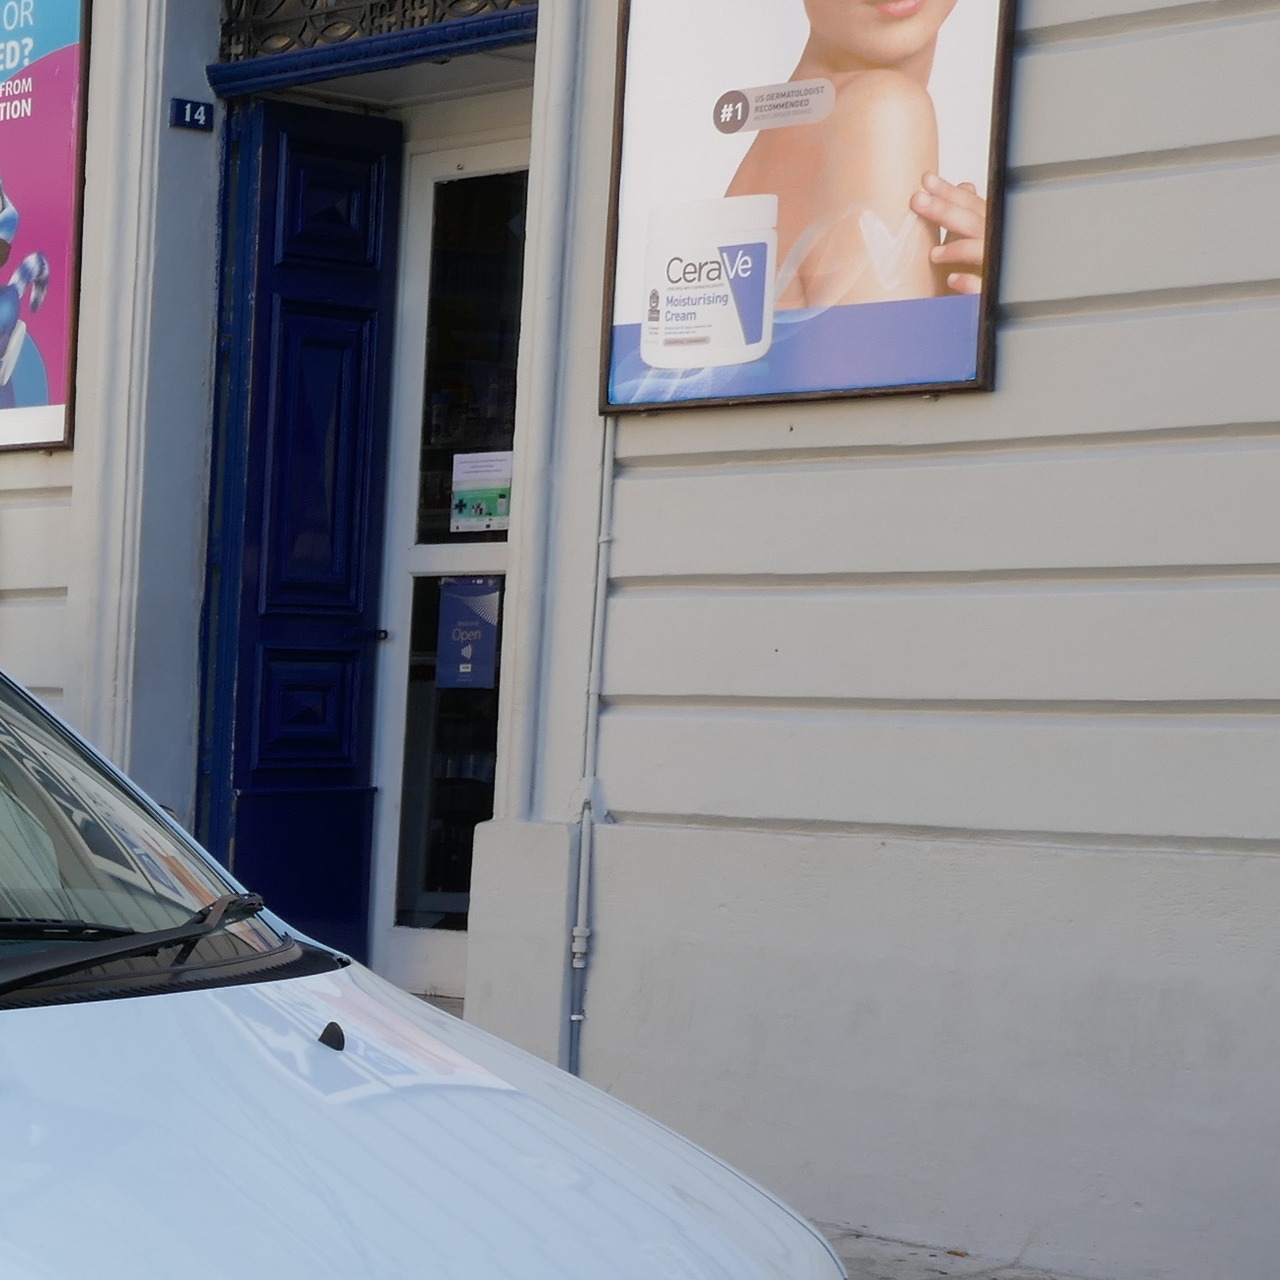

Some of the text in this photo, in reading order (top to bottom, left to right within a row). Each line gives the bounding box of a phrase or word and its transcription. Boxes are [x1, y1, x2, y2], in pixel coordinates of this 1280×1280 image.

[3, 0, 34, 31] OR
[0, 77, 32, 98] FROM
[765, 86, 825, 101] DERMATOLOGIST
[184, 102, 206, 125] 14
[720, 102, 743, 122] #1
[754, 98, 810, 113] RECOMMENDED
[666, 250, 752, 284] CeraVe
[665, 293, 729, 307] Moisturising
[665, 310, 697, 322] Cream
